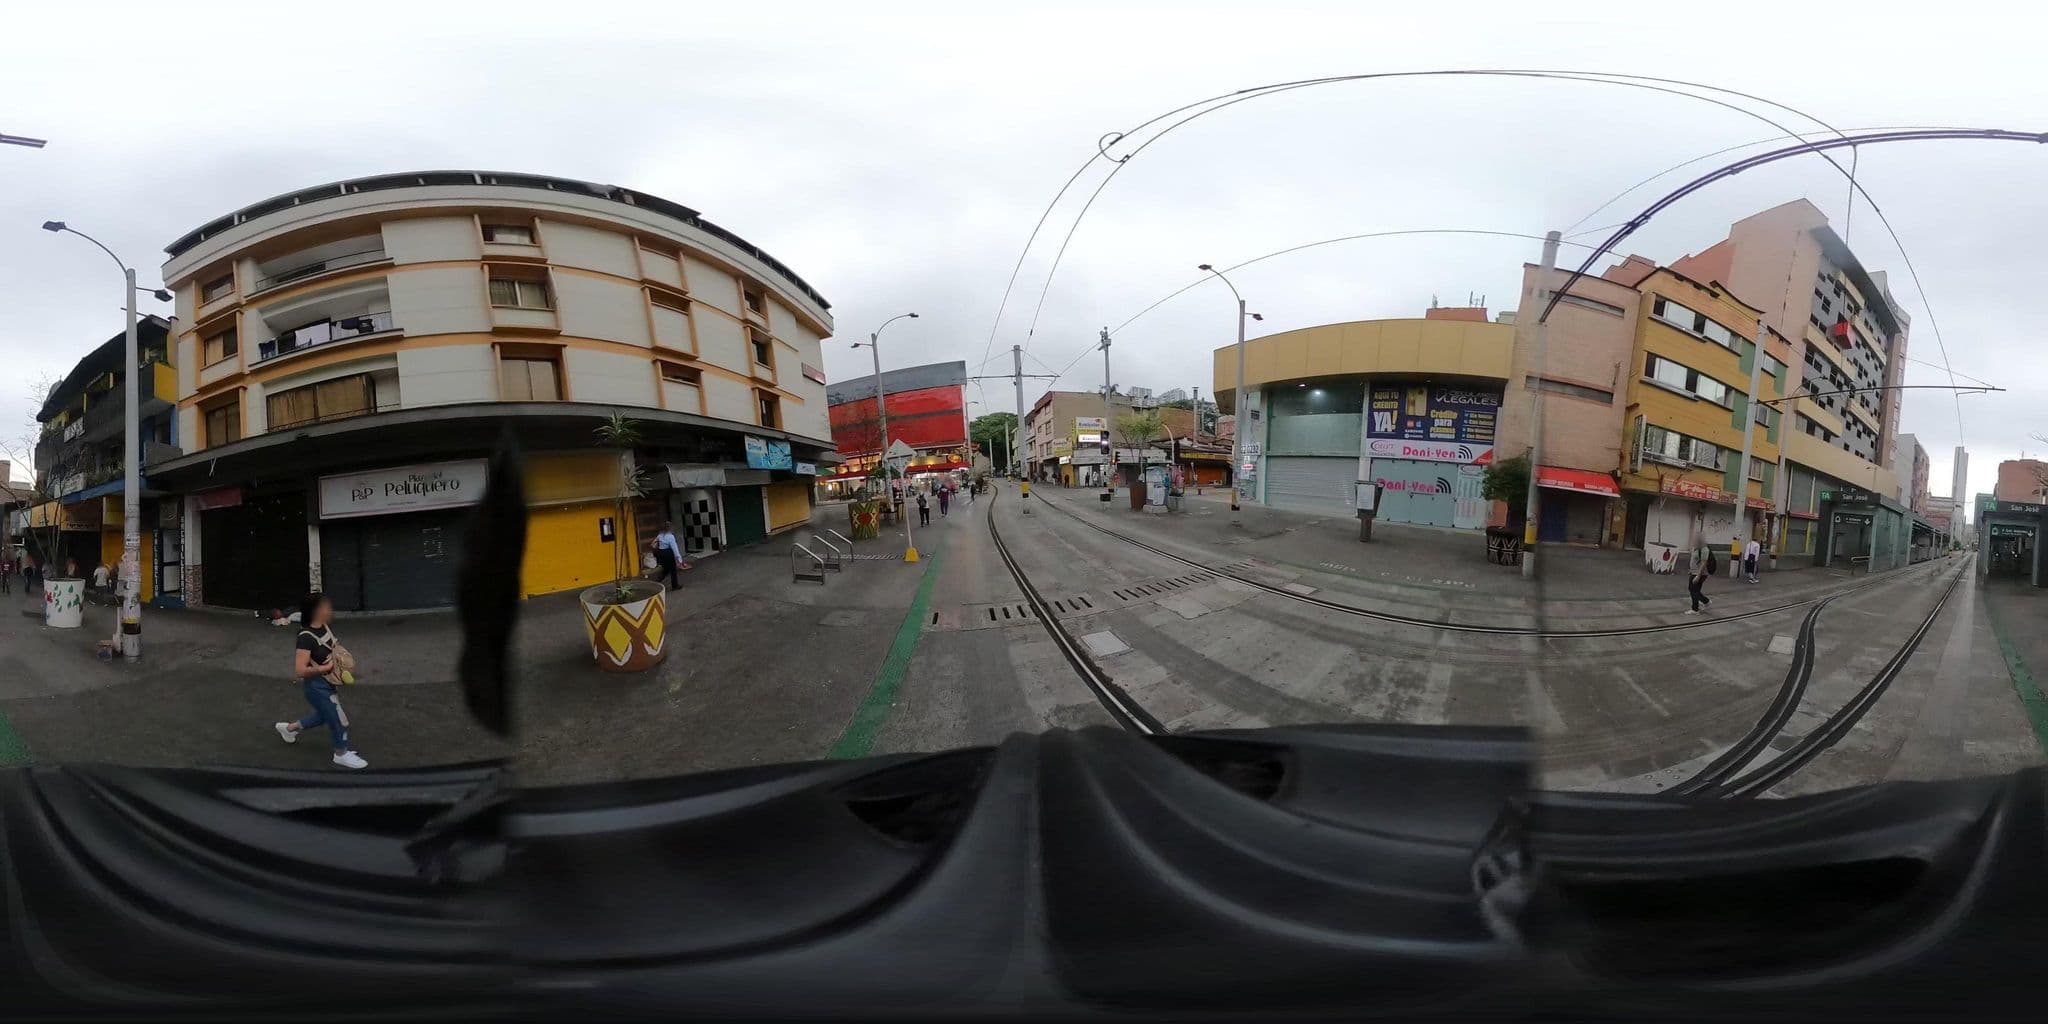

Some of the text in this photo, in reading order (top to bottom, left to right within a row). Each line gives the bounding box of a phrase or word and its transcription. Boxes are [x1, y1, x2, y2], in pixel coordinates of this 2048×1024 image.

[1373, 410, 1398, 432] YA!
[1402, 446, 1456, 459] Dani-Yen
[351, 487, 374, 502] P&P
[384, 480, 460, 496] Peluquero
